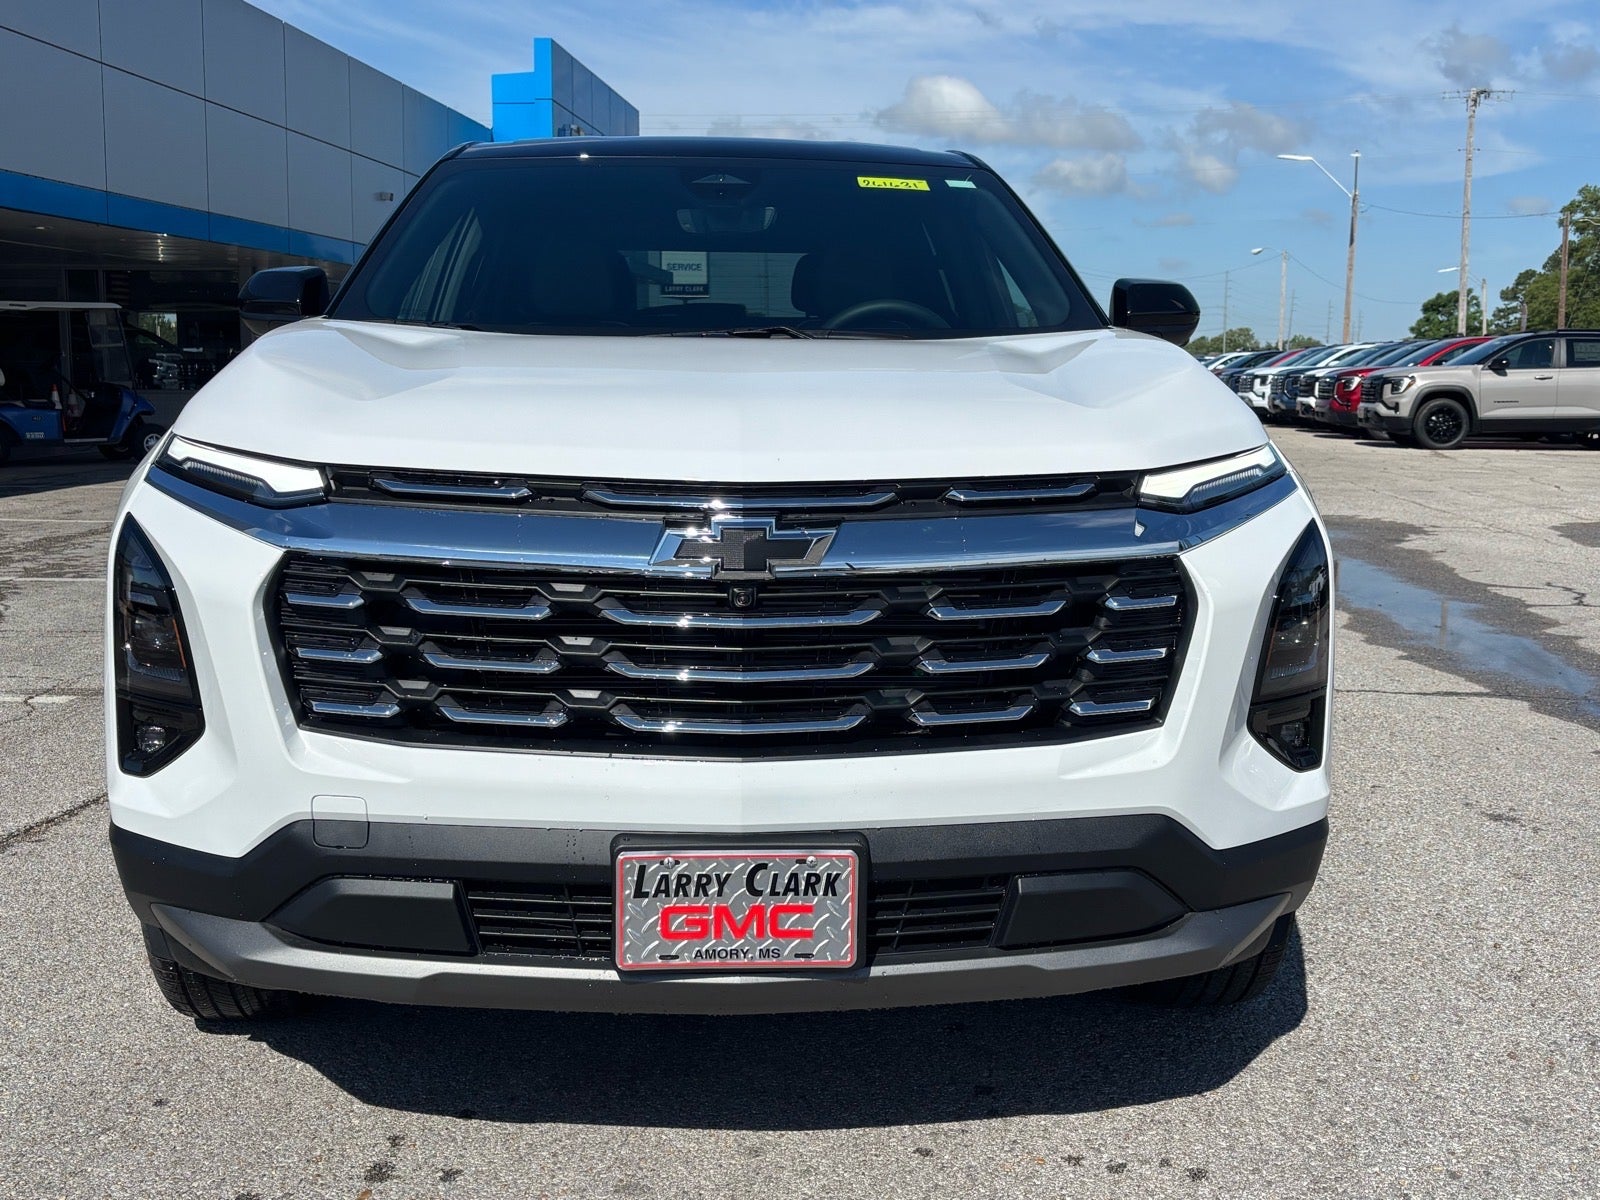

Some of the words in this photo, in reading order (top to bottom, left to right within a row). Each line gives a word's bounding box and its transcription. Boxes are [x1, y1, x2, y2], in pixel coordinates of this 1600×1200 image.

[666, 263, 703, 271] SERVICE
[632, 864, 732, 899] LARRY
[745, 863, 842, 897] CLARK
[660, 904, 815, 941] GMC
[693, 949, 754, 961] AMORY,
[758, 948, 781, 959] MS
